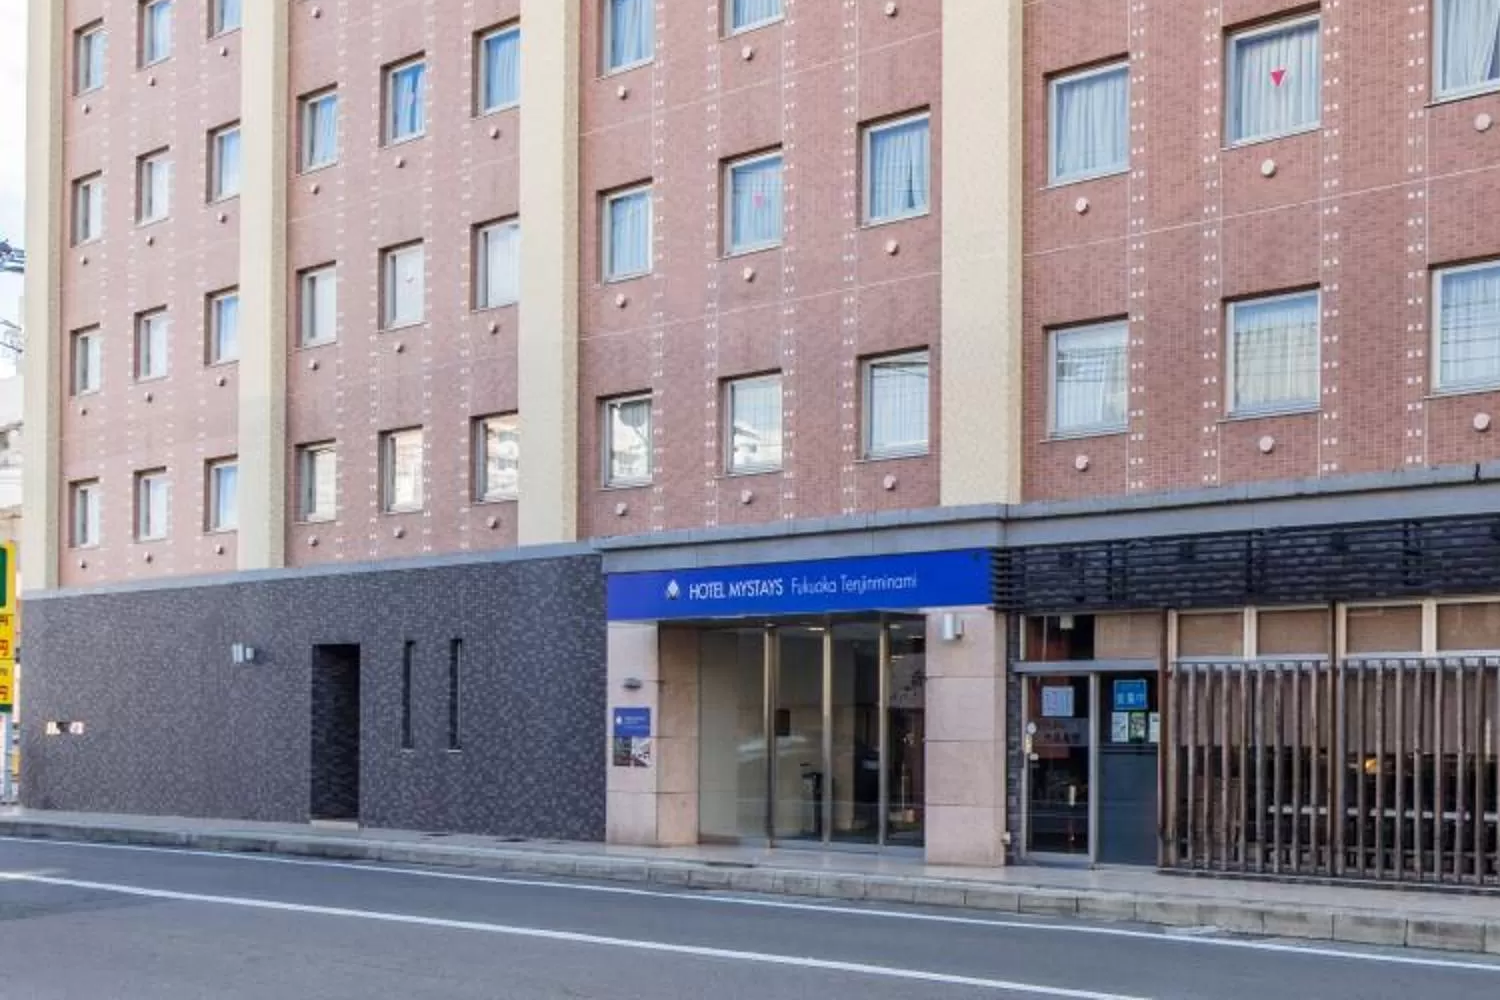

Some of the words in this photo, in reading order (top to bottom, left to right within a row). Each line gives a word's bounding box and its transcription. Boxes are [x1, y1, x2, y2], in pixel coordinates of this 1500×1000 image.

[689, 581, 725, 600] HOTEL
[728, 578, 784, 598] MYSTAYS
[791, 576, 837, 595] Fukuoka
